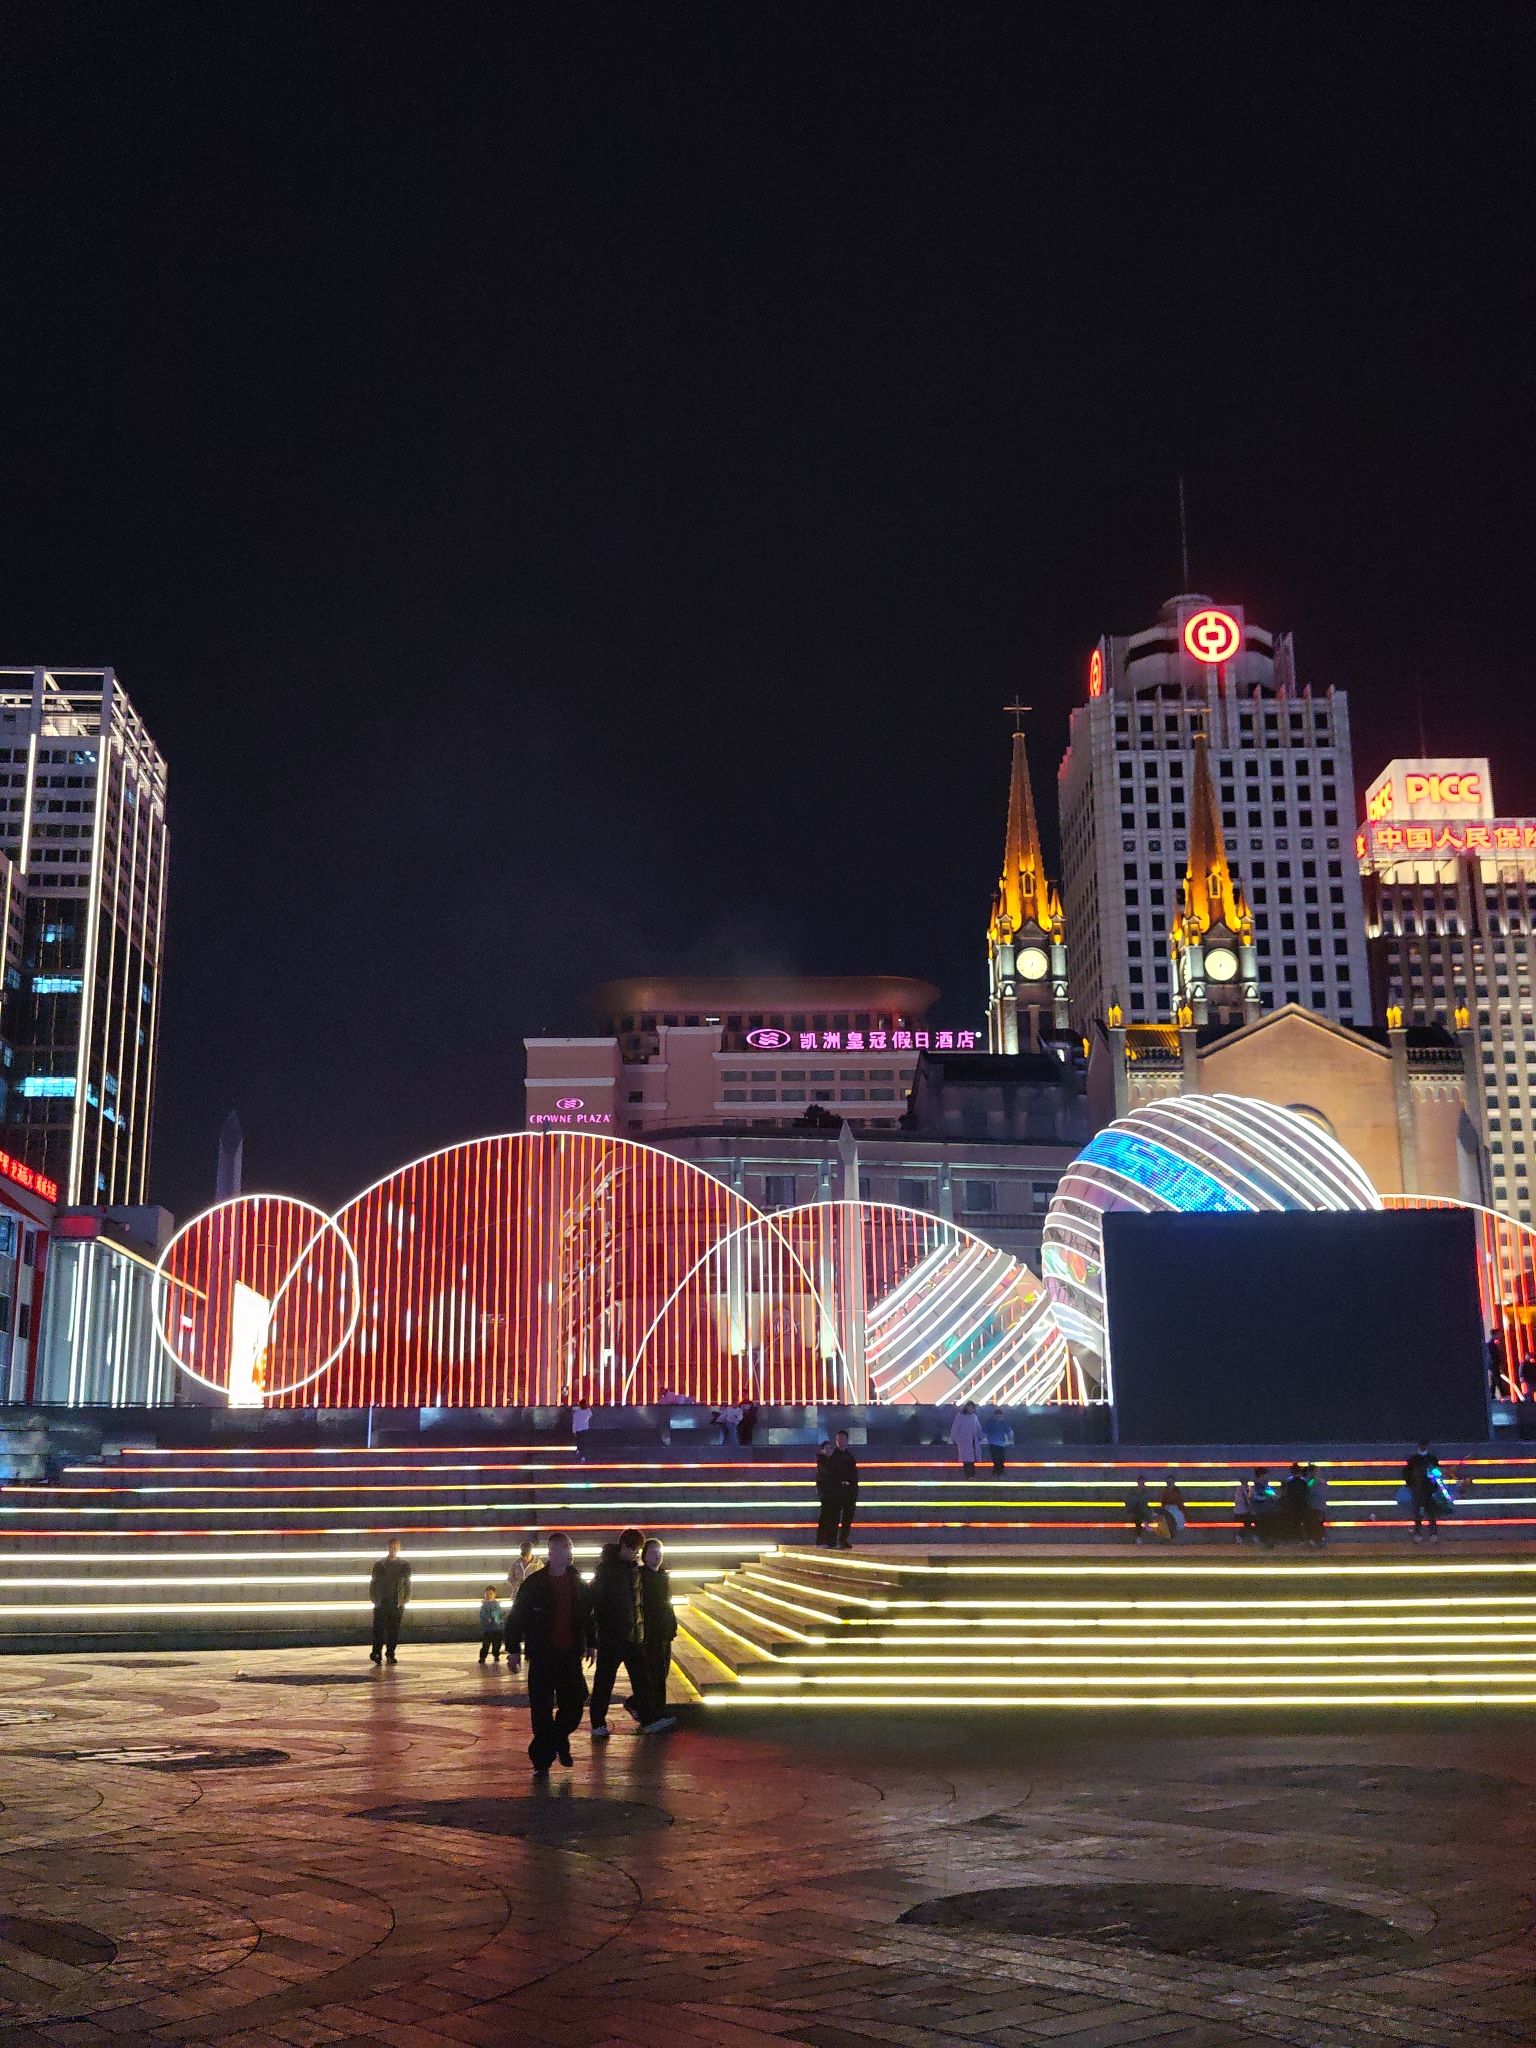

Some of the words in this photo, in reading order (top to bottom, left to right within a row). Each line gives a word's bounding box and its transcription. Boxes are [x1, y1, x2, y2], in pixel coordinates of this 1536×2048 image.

[1405, 774, 1481, 804] PICC
[800, 1031, 975, 1050] 凯洲皇冠假日酒店
[577, 1114, 611, 1123] PLAZA
